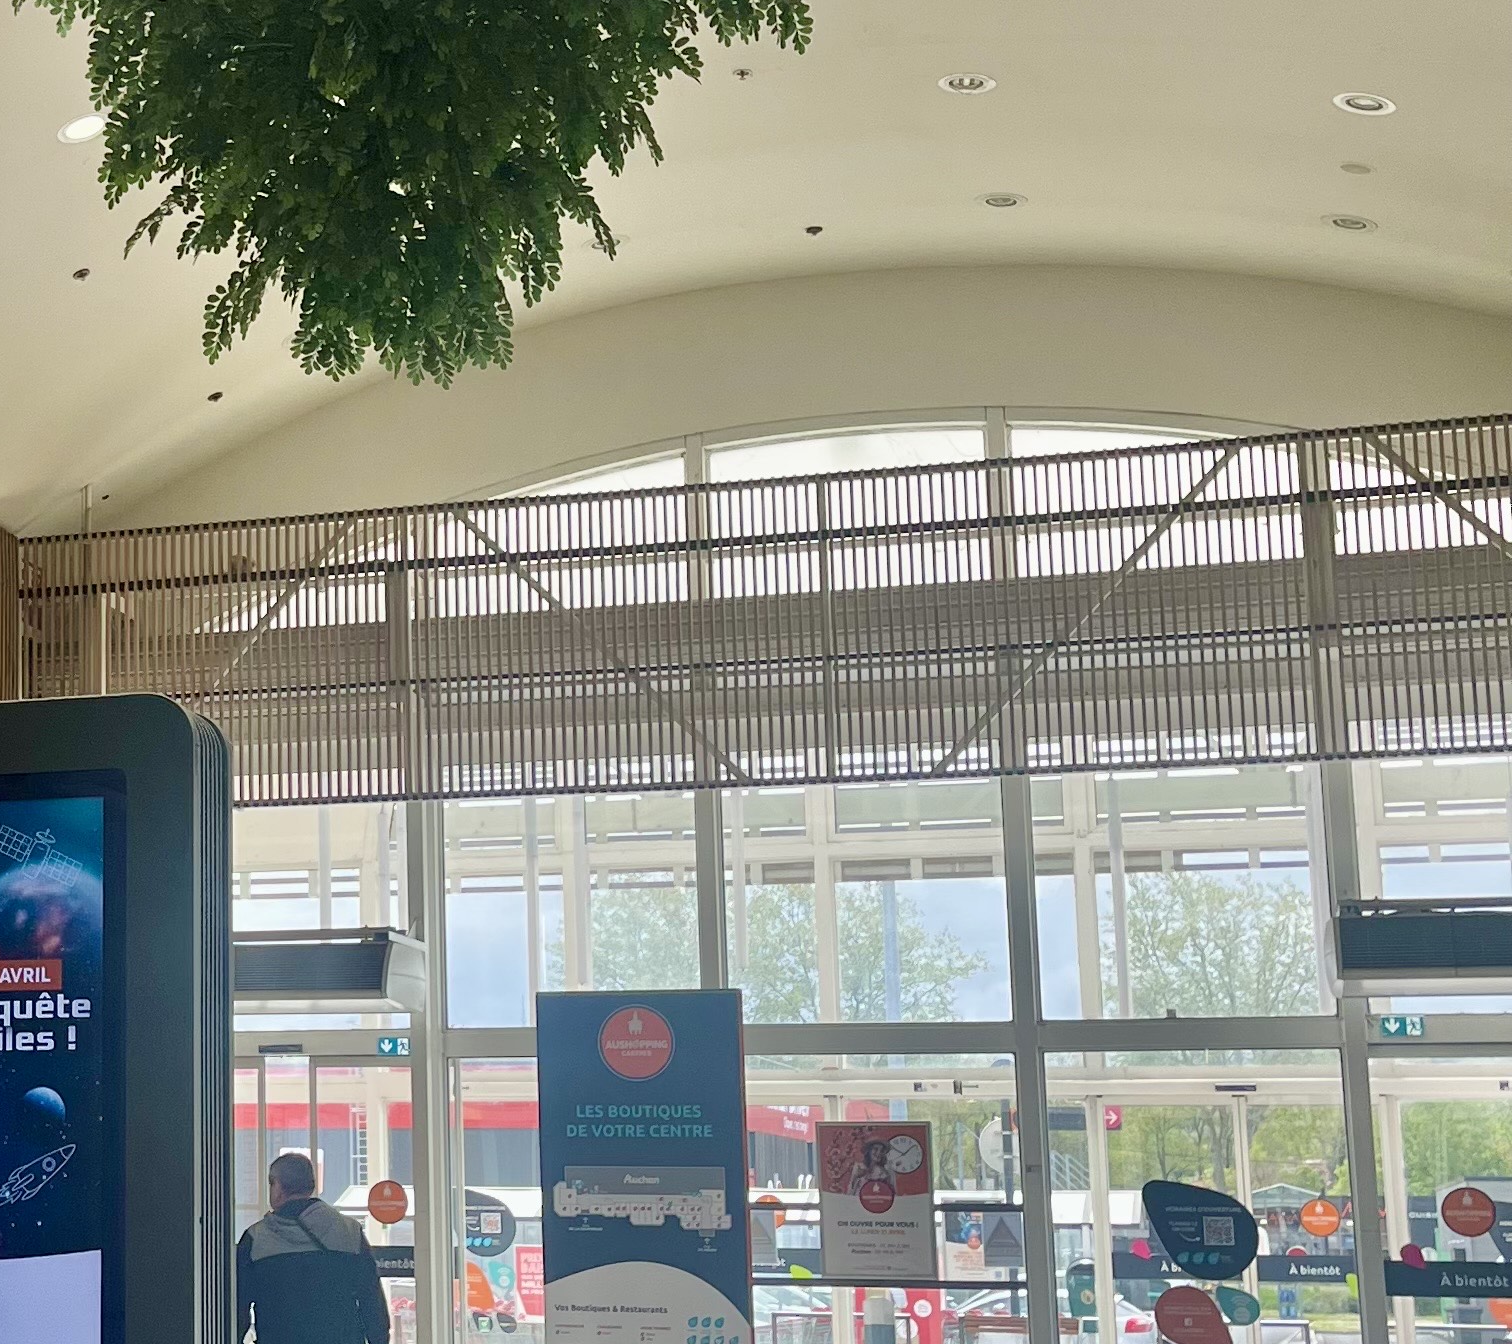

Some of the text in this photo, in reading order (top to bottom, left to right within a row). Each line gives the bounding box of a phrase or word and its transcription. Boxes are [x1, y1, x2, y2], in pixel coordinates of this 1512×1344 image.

[67, 1025, 77, 1051] !
[576, 1105, 701, 1121] LES BOUTIQUES
[566, 1124, 713, 1138] DE VOTRE CENTRE
[623, 1173, 660, 1185] Auchan
[1289, 1262, 1341, 1276] À bientôt
[1440, 1274, 1510, 1288] À bientôt
[554, 1304, 569, 1312] Vos
[571, 1304, 610, 1314] Boutiques
[620, 1305, 668, 1314] Restaurants
